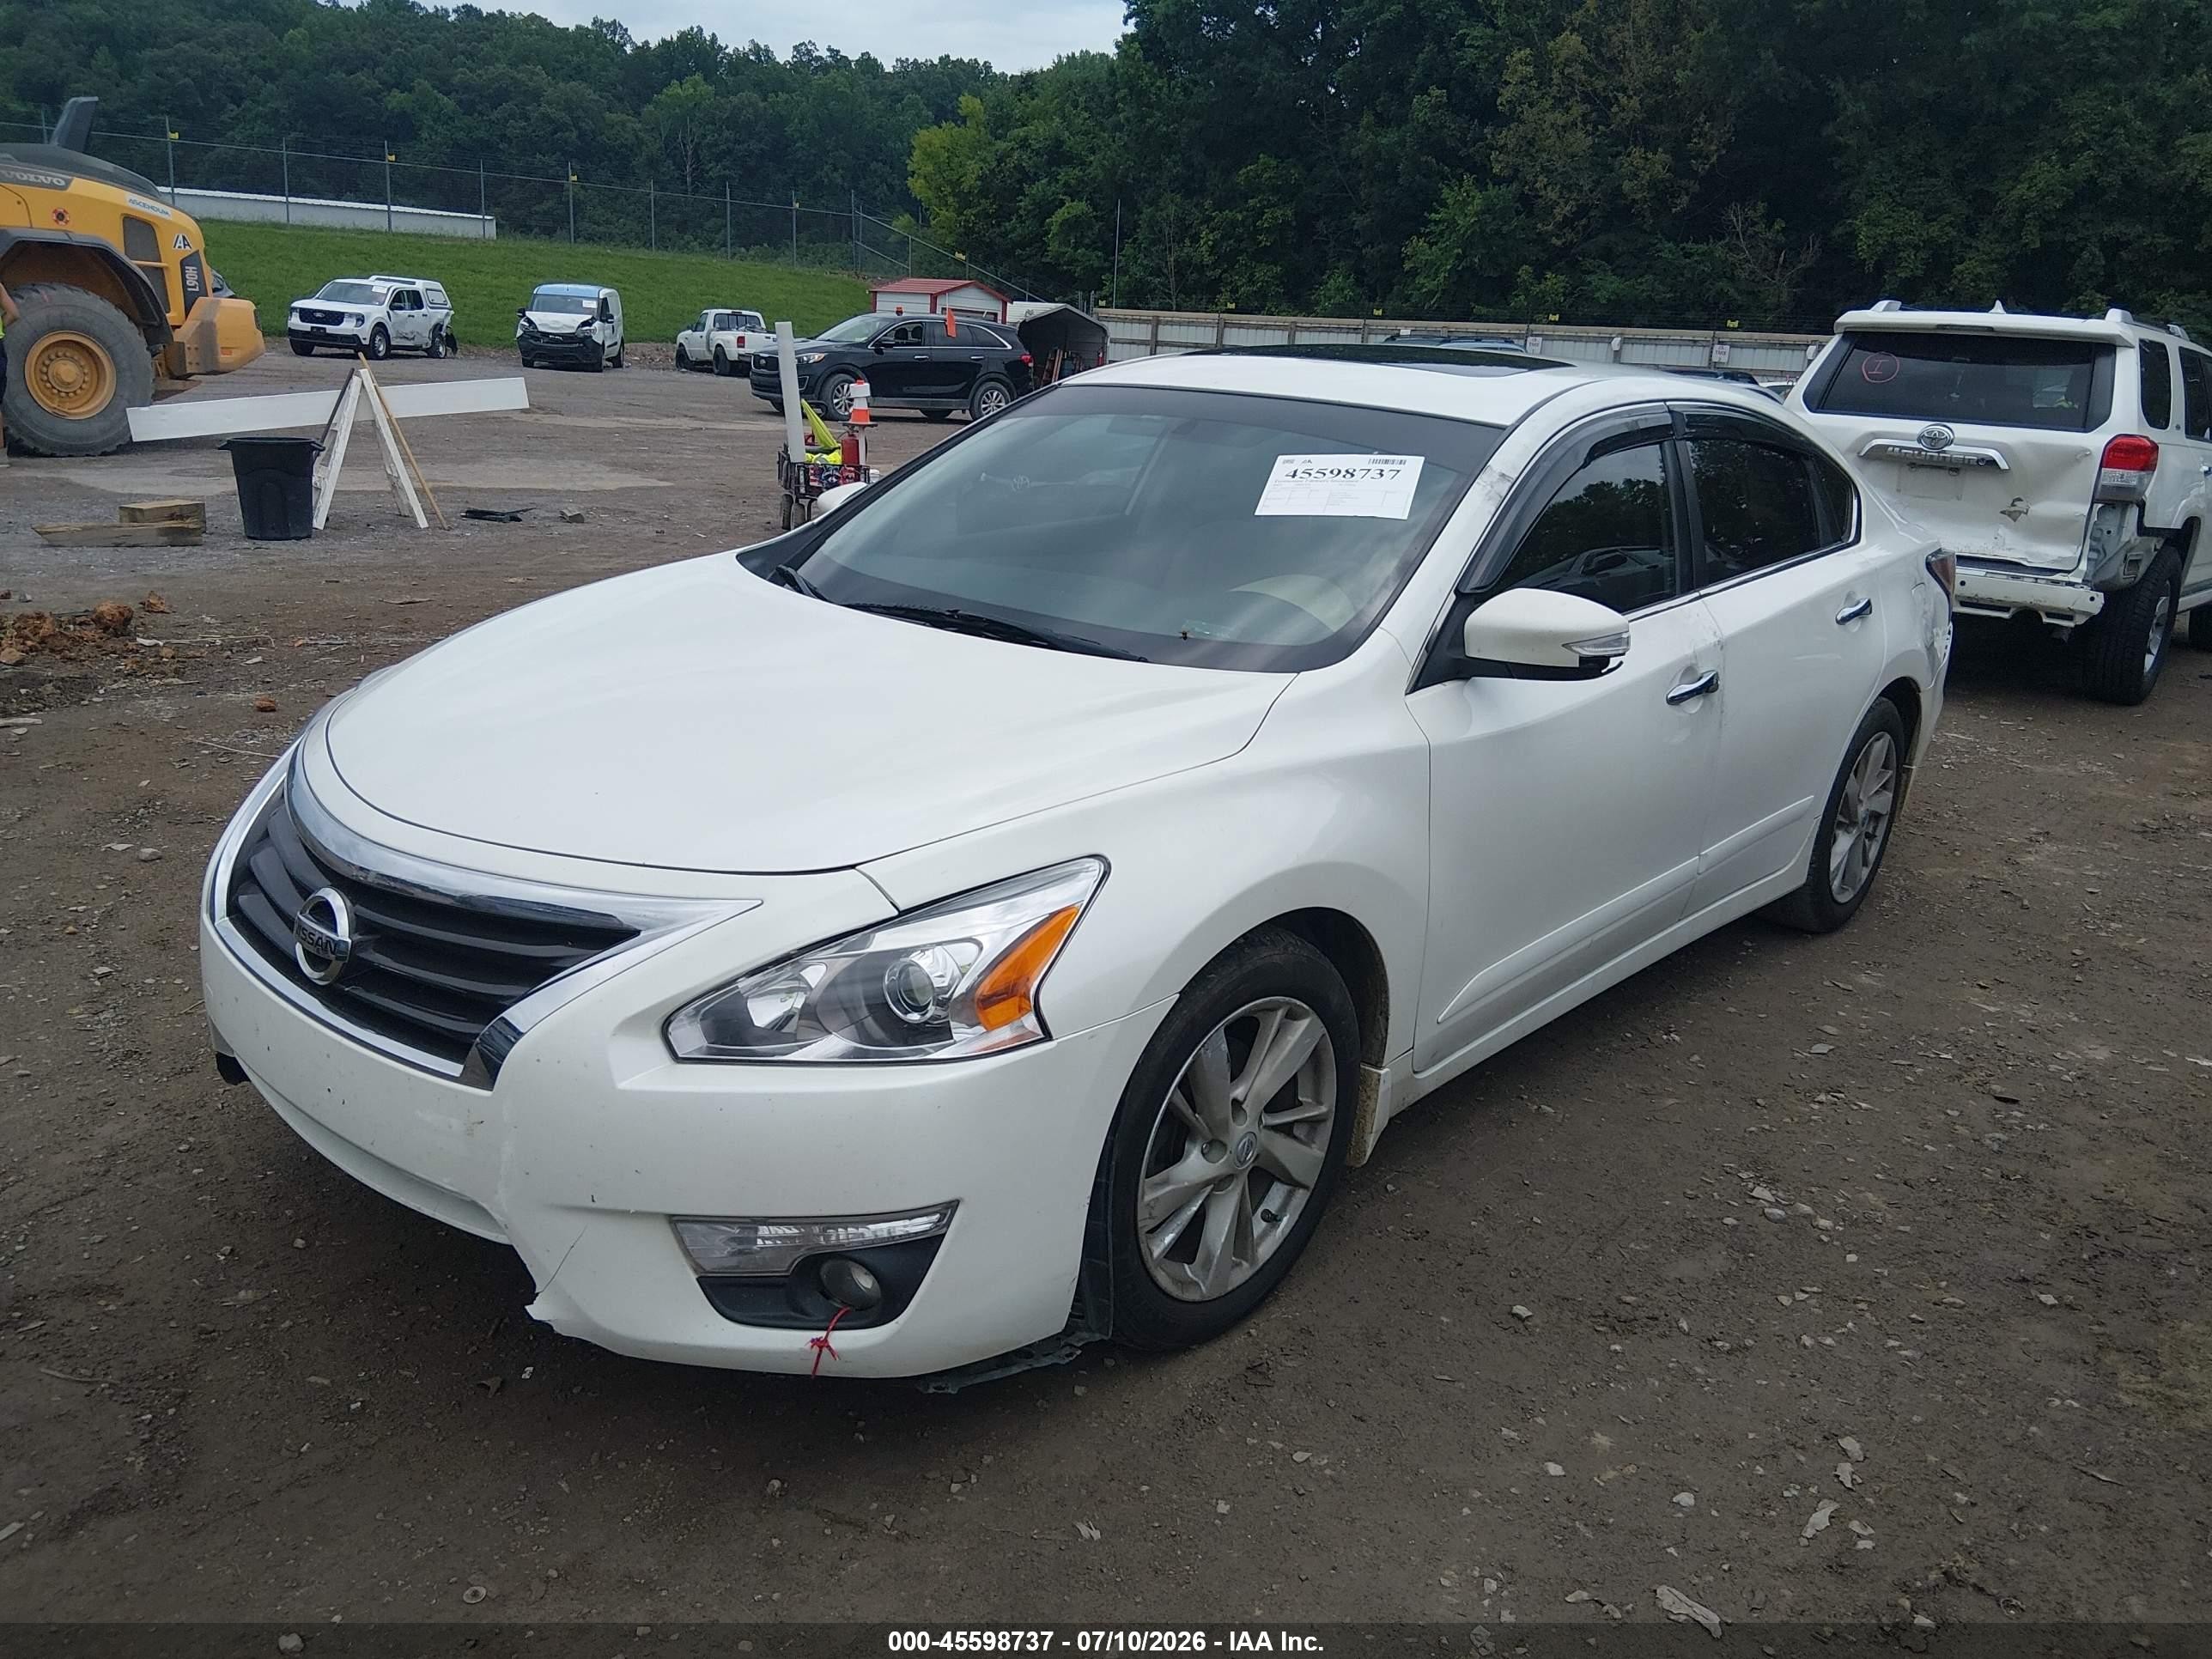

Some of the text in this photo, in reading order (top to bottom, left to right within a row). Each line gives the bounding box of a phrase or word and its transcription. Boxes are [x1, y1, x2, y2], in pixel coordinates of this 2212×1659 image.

[185, 265, 200, 292] L90H
[1285, 468, 1401, 481] 45598737
[295, 927, 337, 956] NISSAN
